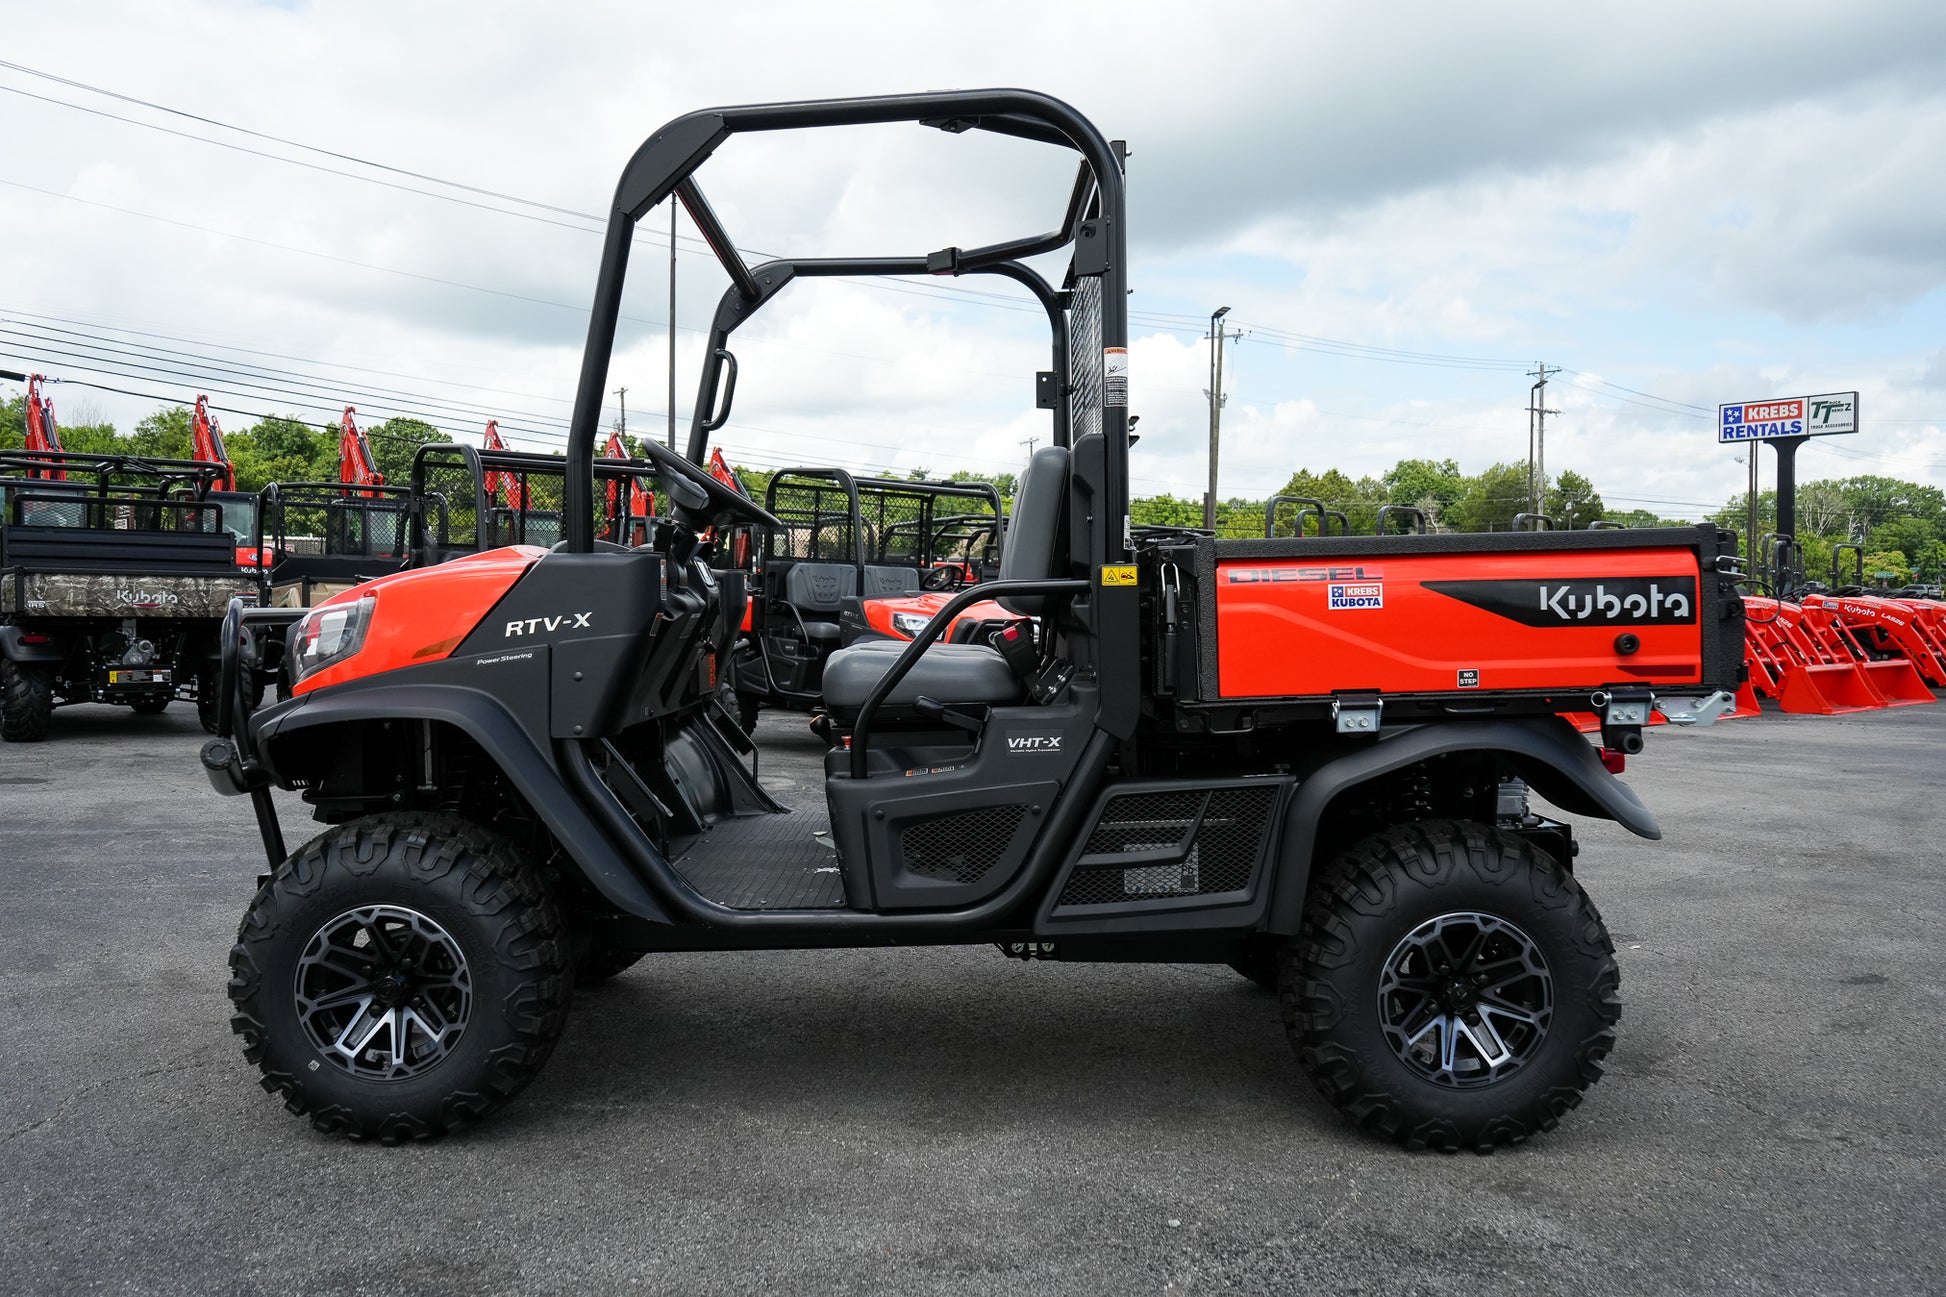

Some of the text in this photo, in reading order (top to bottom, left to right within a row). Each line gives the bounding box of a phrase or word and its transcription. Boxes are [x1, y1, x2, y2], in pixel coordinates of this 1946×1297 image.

[1748, 403, 1799, 420] KREBS
[1723, 420, 1803, 439] RENTALS
[1229, 567, 1383, 583] DIESEL
[116, 589, 178, 605] Kubota
[1347, 586, 1379, 596] KREBS
[1331, 597, 1381, 607] KUBOTA
[1539, 584, 1690, 620] Kubota
[1844, 604, 1876, 617] Kubota
[505, 611, 593, 637] RTV-X
[477, 653, 533, 665] Power Steering
[1007, 736, 1062, 748] VHT-X
